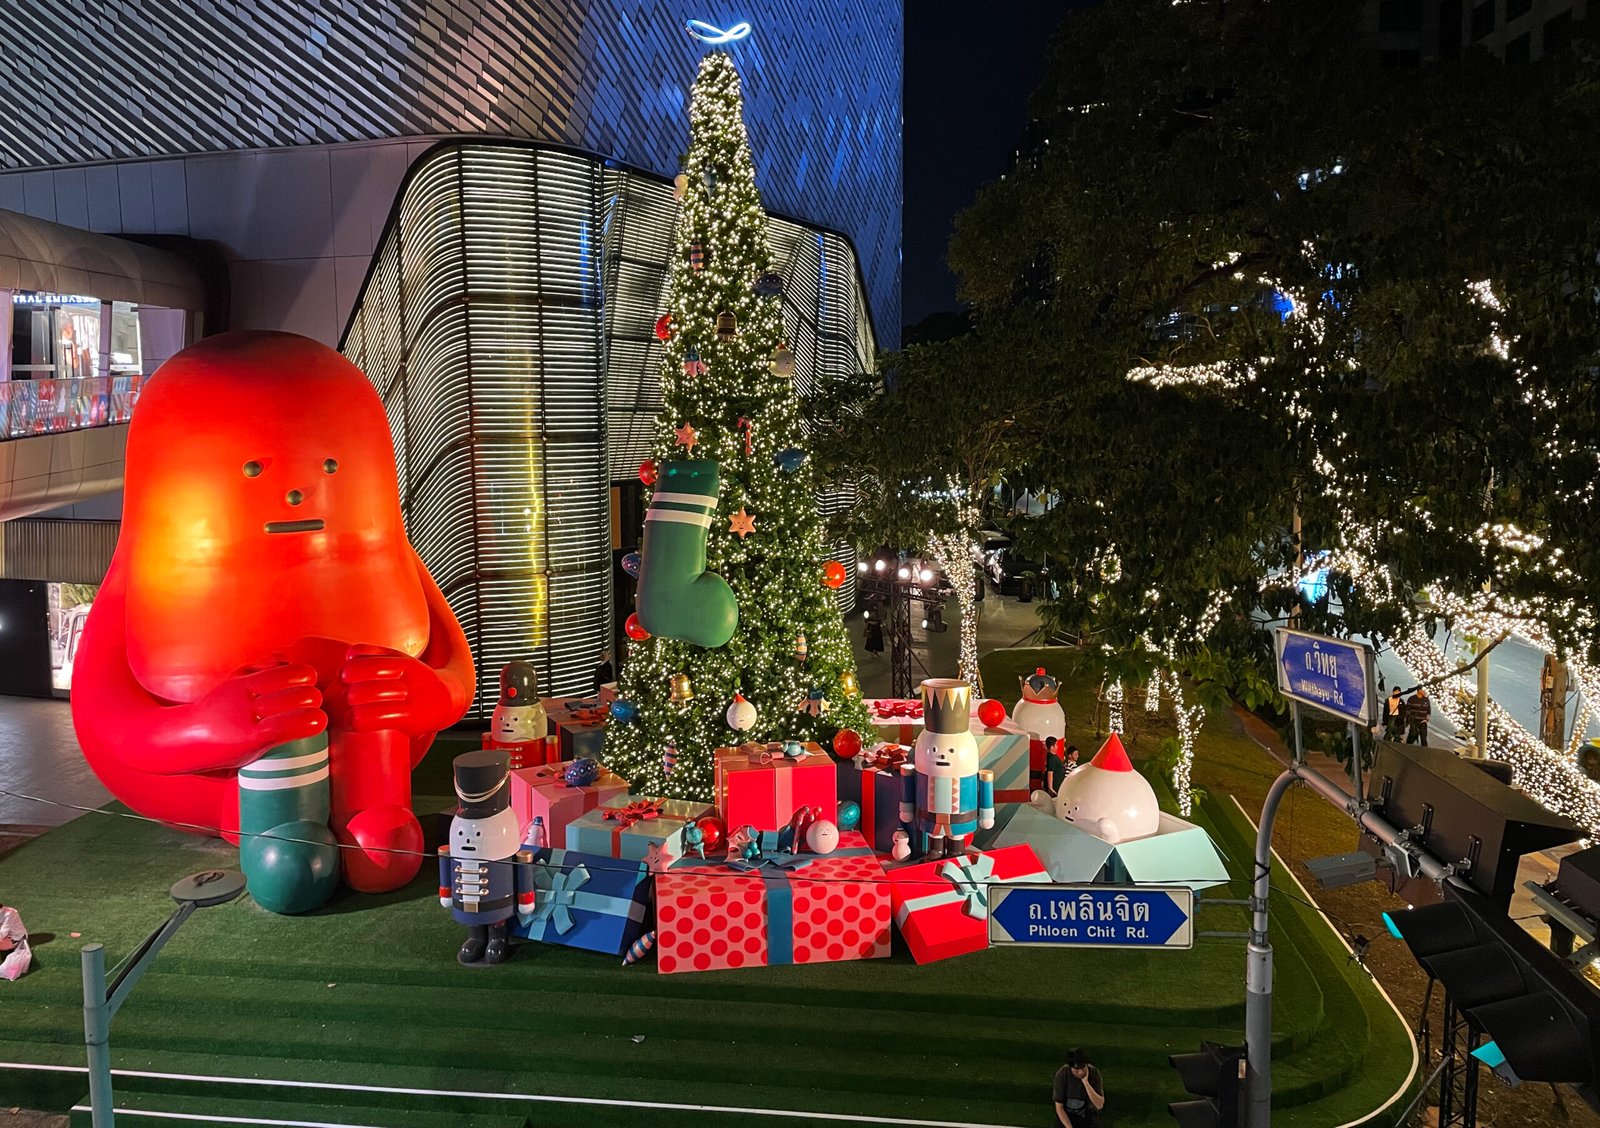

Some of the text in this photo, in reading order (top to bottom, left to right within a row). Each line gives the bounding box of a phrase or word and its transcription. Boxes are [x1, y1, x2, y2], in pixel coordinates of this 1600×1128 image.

[1304, 641, 1338, 688] ถ.วิทยุ
[1333, 689, 1345, 707] Rd.
[1029, 893, 1150, 922] ถ.เพลินจิต
[1029, 925, 1149, 938] Phloen Chit Rd.
